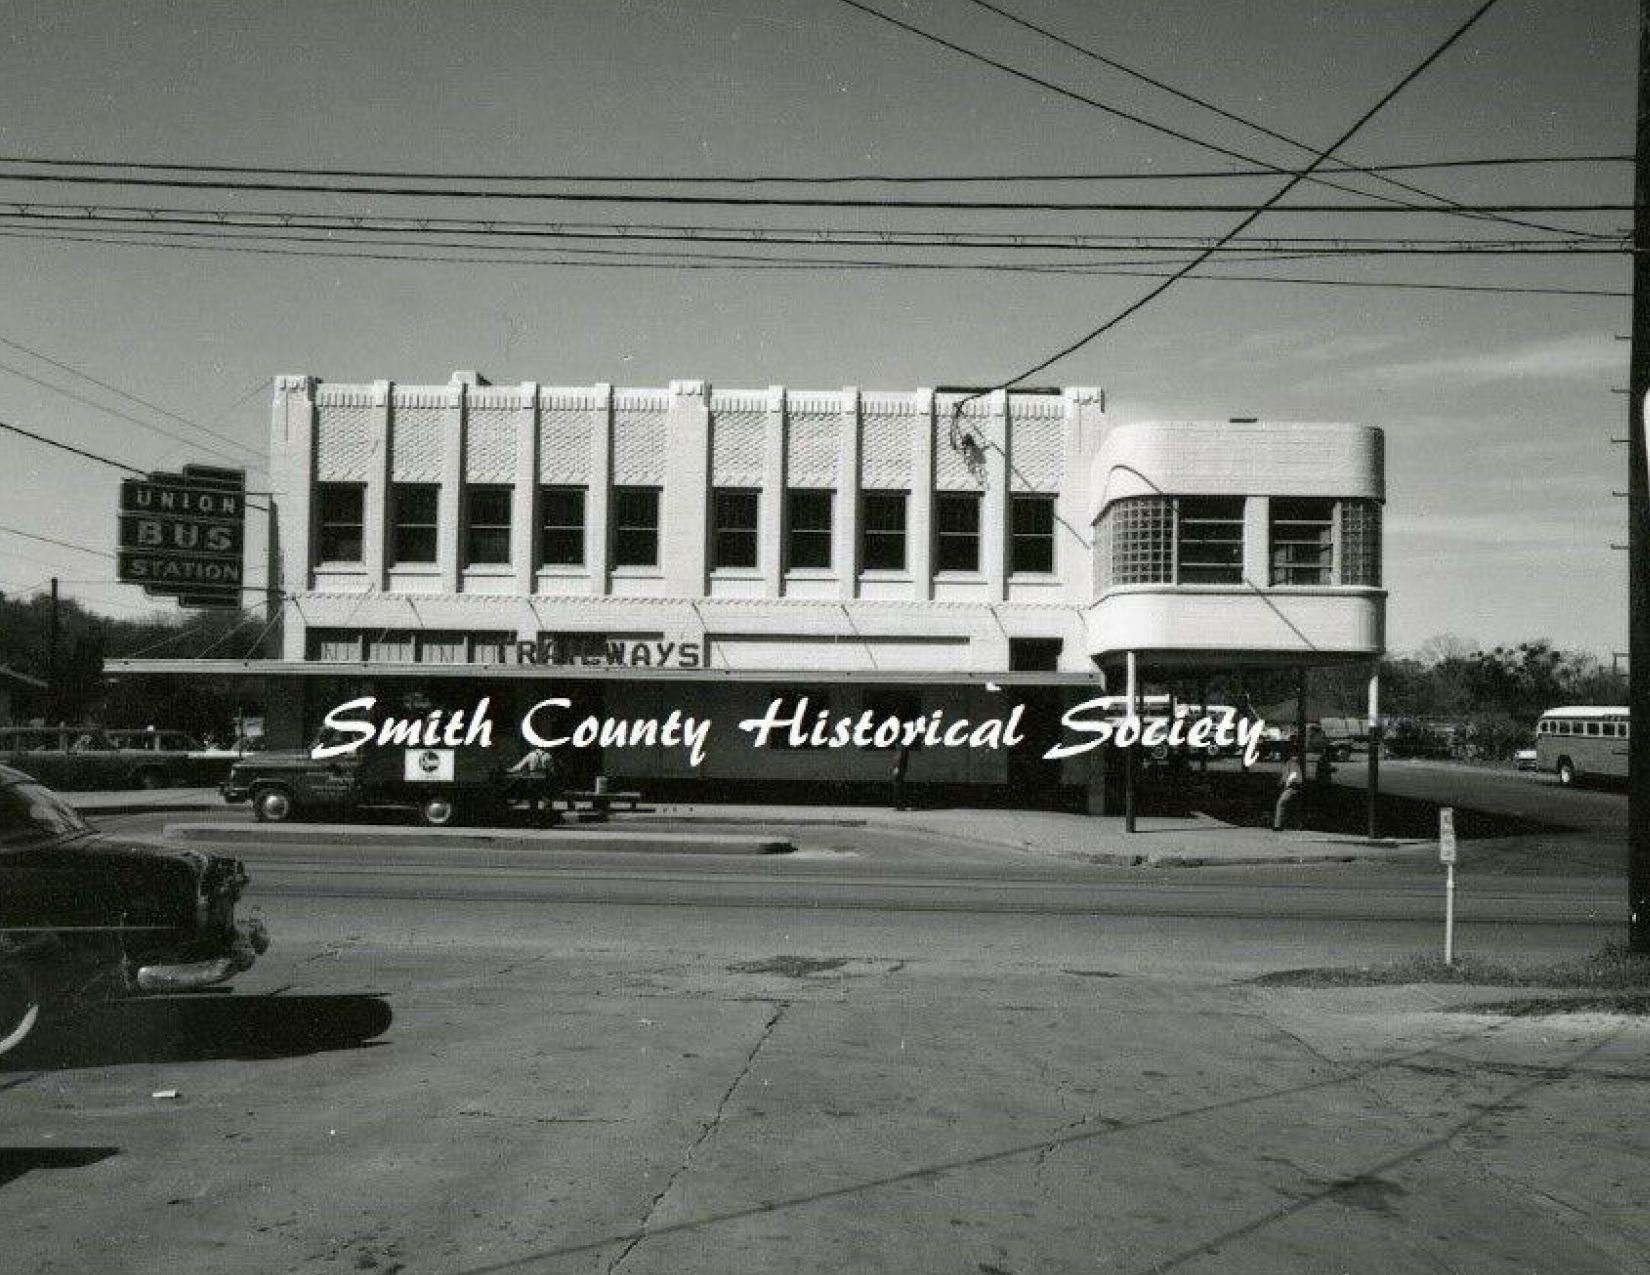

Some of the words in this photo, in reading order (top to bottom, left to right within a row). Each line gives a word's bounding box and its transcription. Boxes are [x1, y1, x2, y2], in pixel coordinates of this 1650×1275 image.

[136, 489, 235, 514] UNION
[137, 520, 233, 551] BUS
[130, 558, 239, 581] STATION
